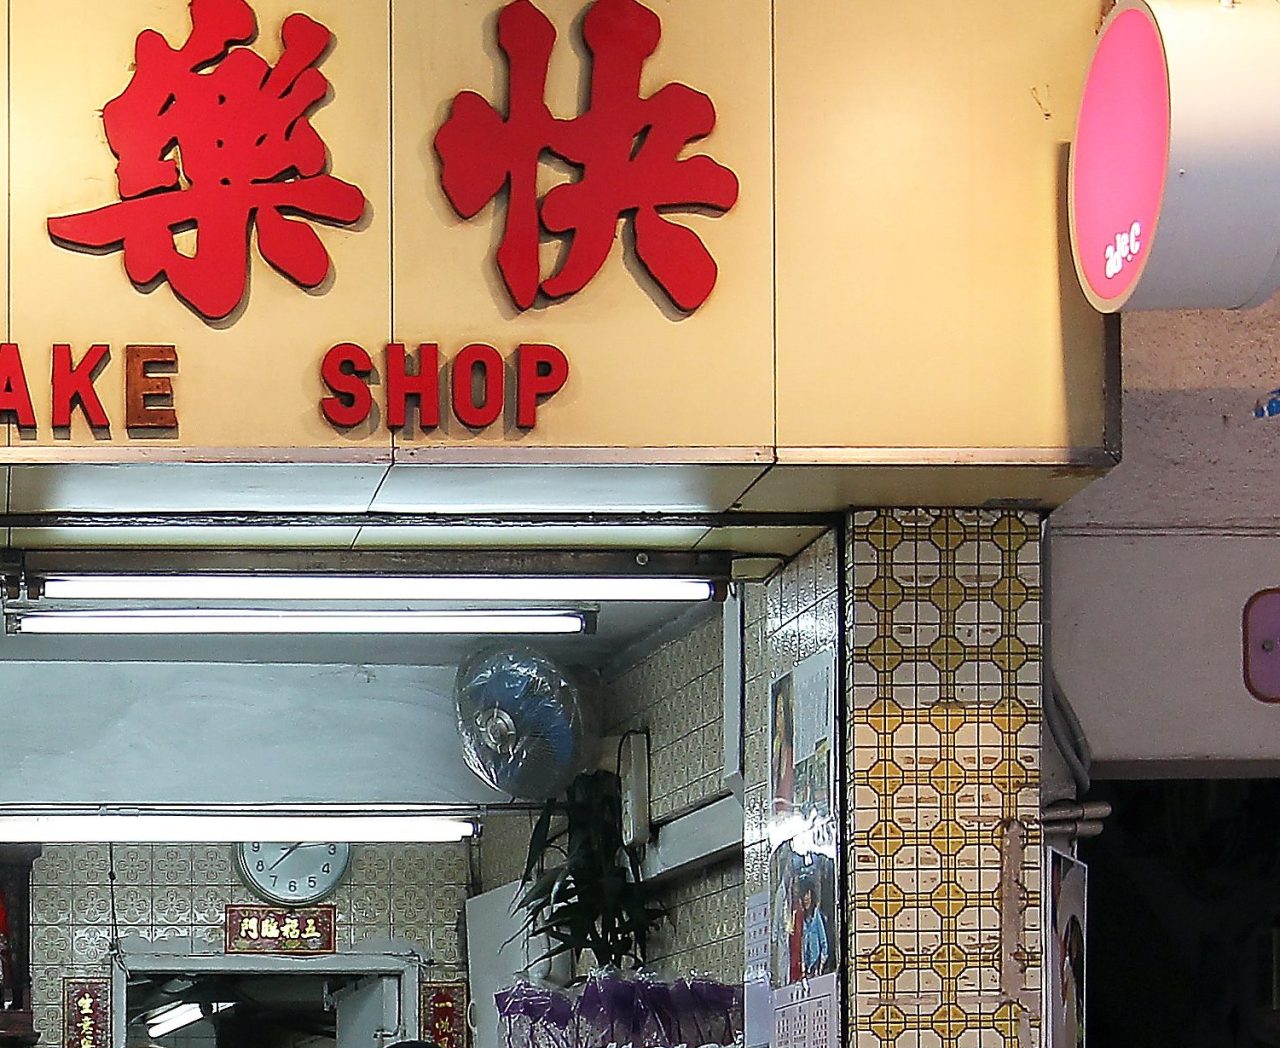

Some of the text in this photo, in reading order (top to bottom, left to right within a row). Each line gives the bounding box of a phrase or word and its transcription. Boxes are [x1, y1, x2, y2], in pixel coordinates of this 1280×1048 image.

[321, 343, 570, 429] SHOP
[252, 842, 260, 852] 9
[328, 844, 336, 855] 3
[256, 860, 264, 872] 8
[322, 863, 330, 874] 4
[270, 875, 278, 887] 7
[288, 881, 297, 892] 6
[308, 876, 317, 888] 5
